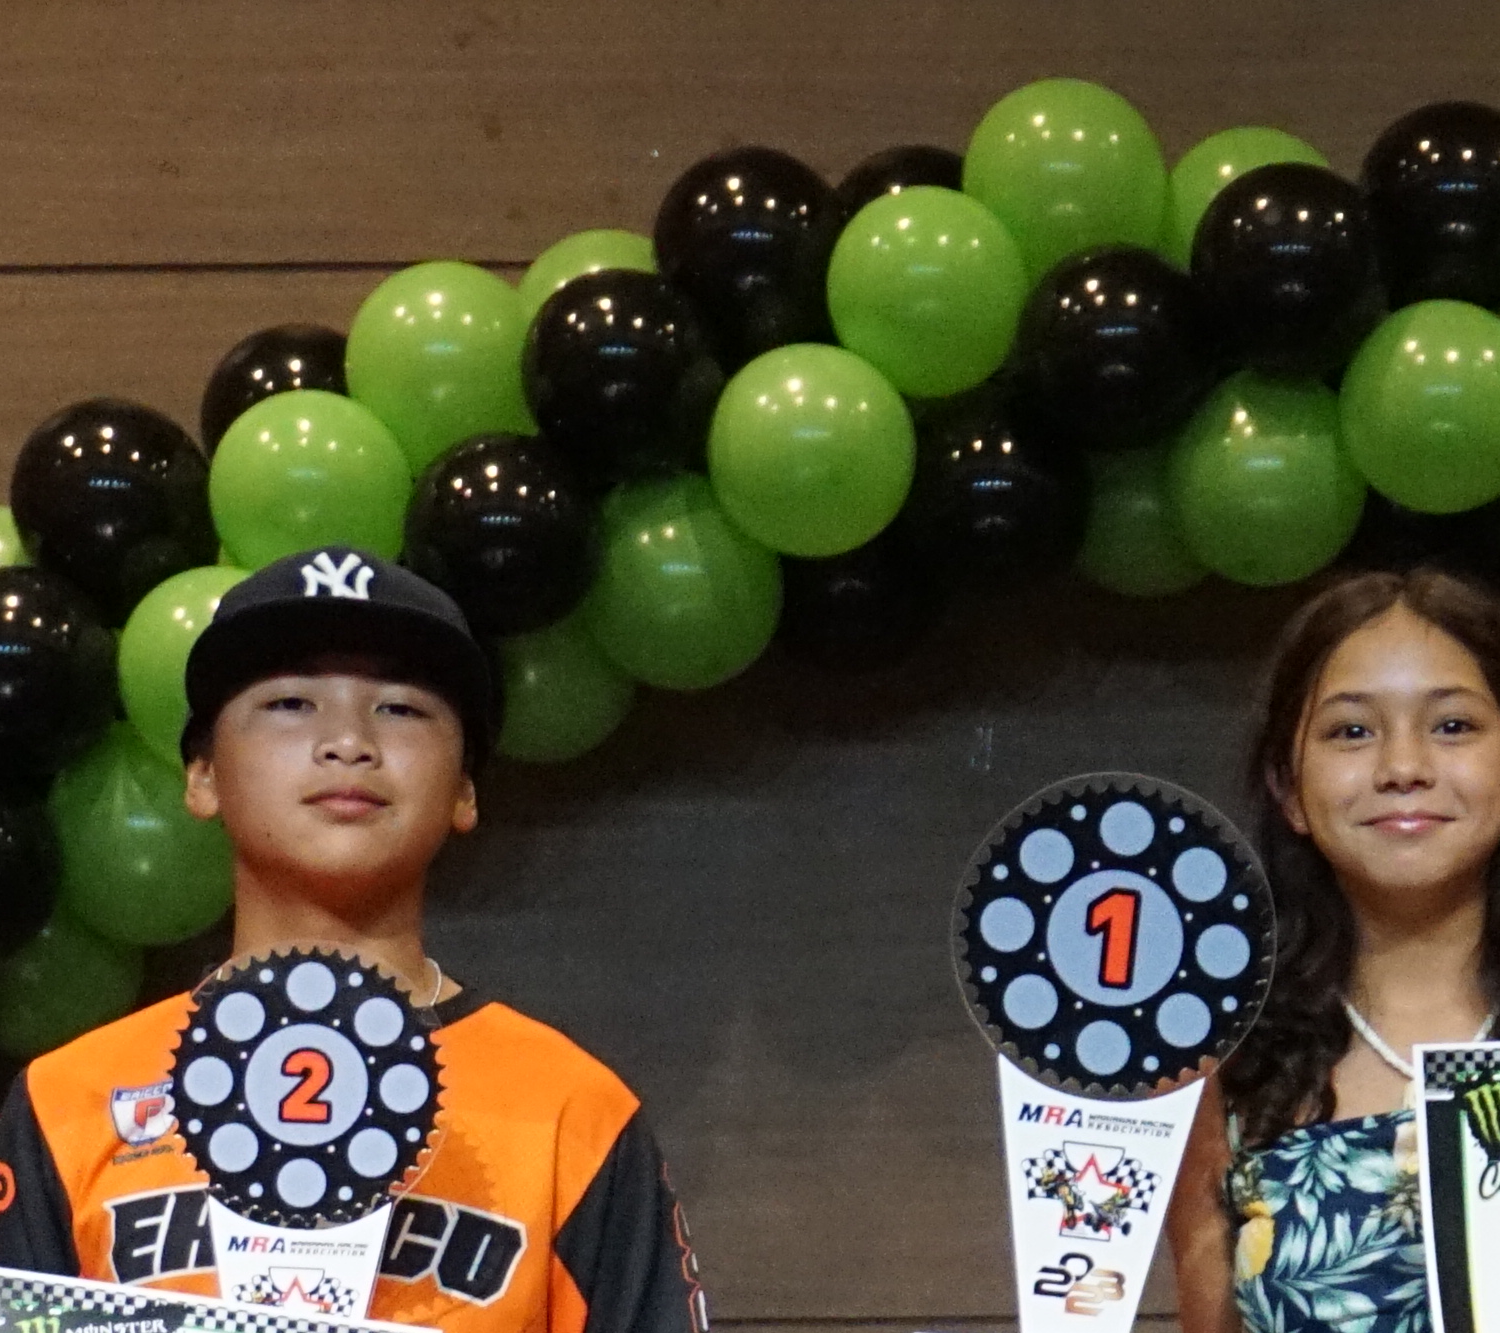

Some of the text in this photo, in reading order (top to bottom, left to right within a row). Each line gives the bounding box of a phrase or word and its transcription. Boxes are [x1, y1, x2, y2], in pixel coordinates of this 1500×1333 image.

[301, 551, 374, 600] NY
[1085, 887, 1142, 990] 1
[279, 1047, 334, 1124] 2
[1018, 1103, 1083, 1128] MRA
[227, 1236, 286, 1254] MRA
